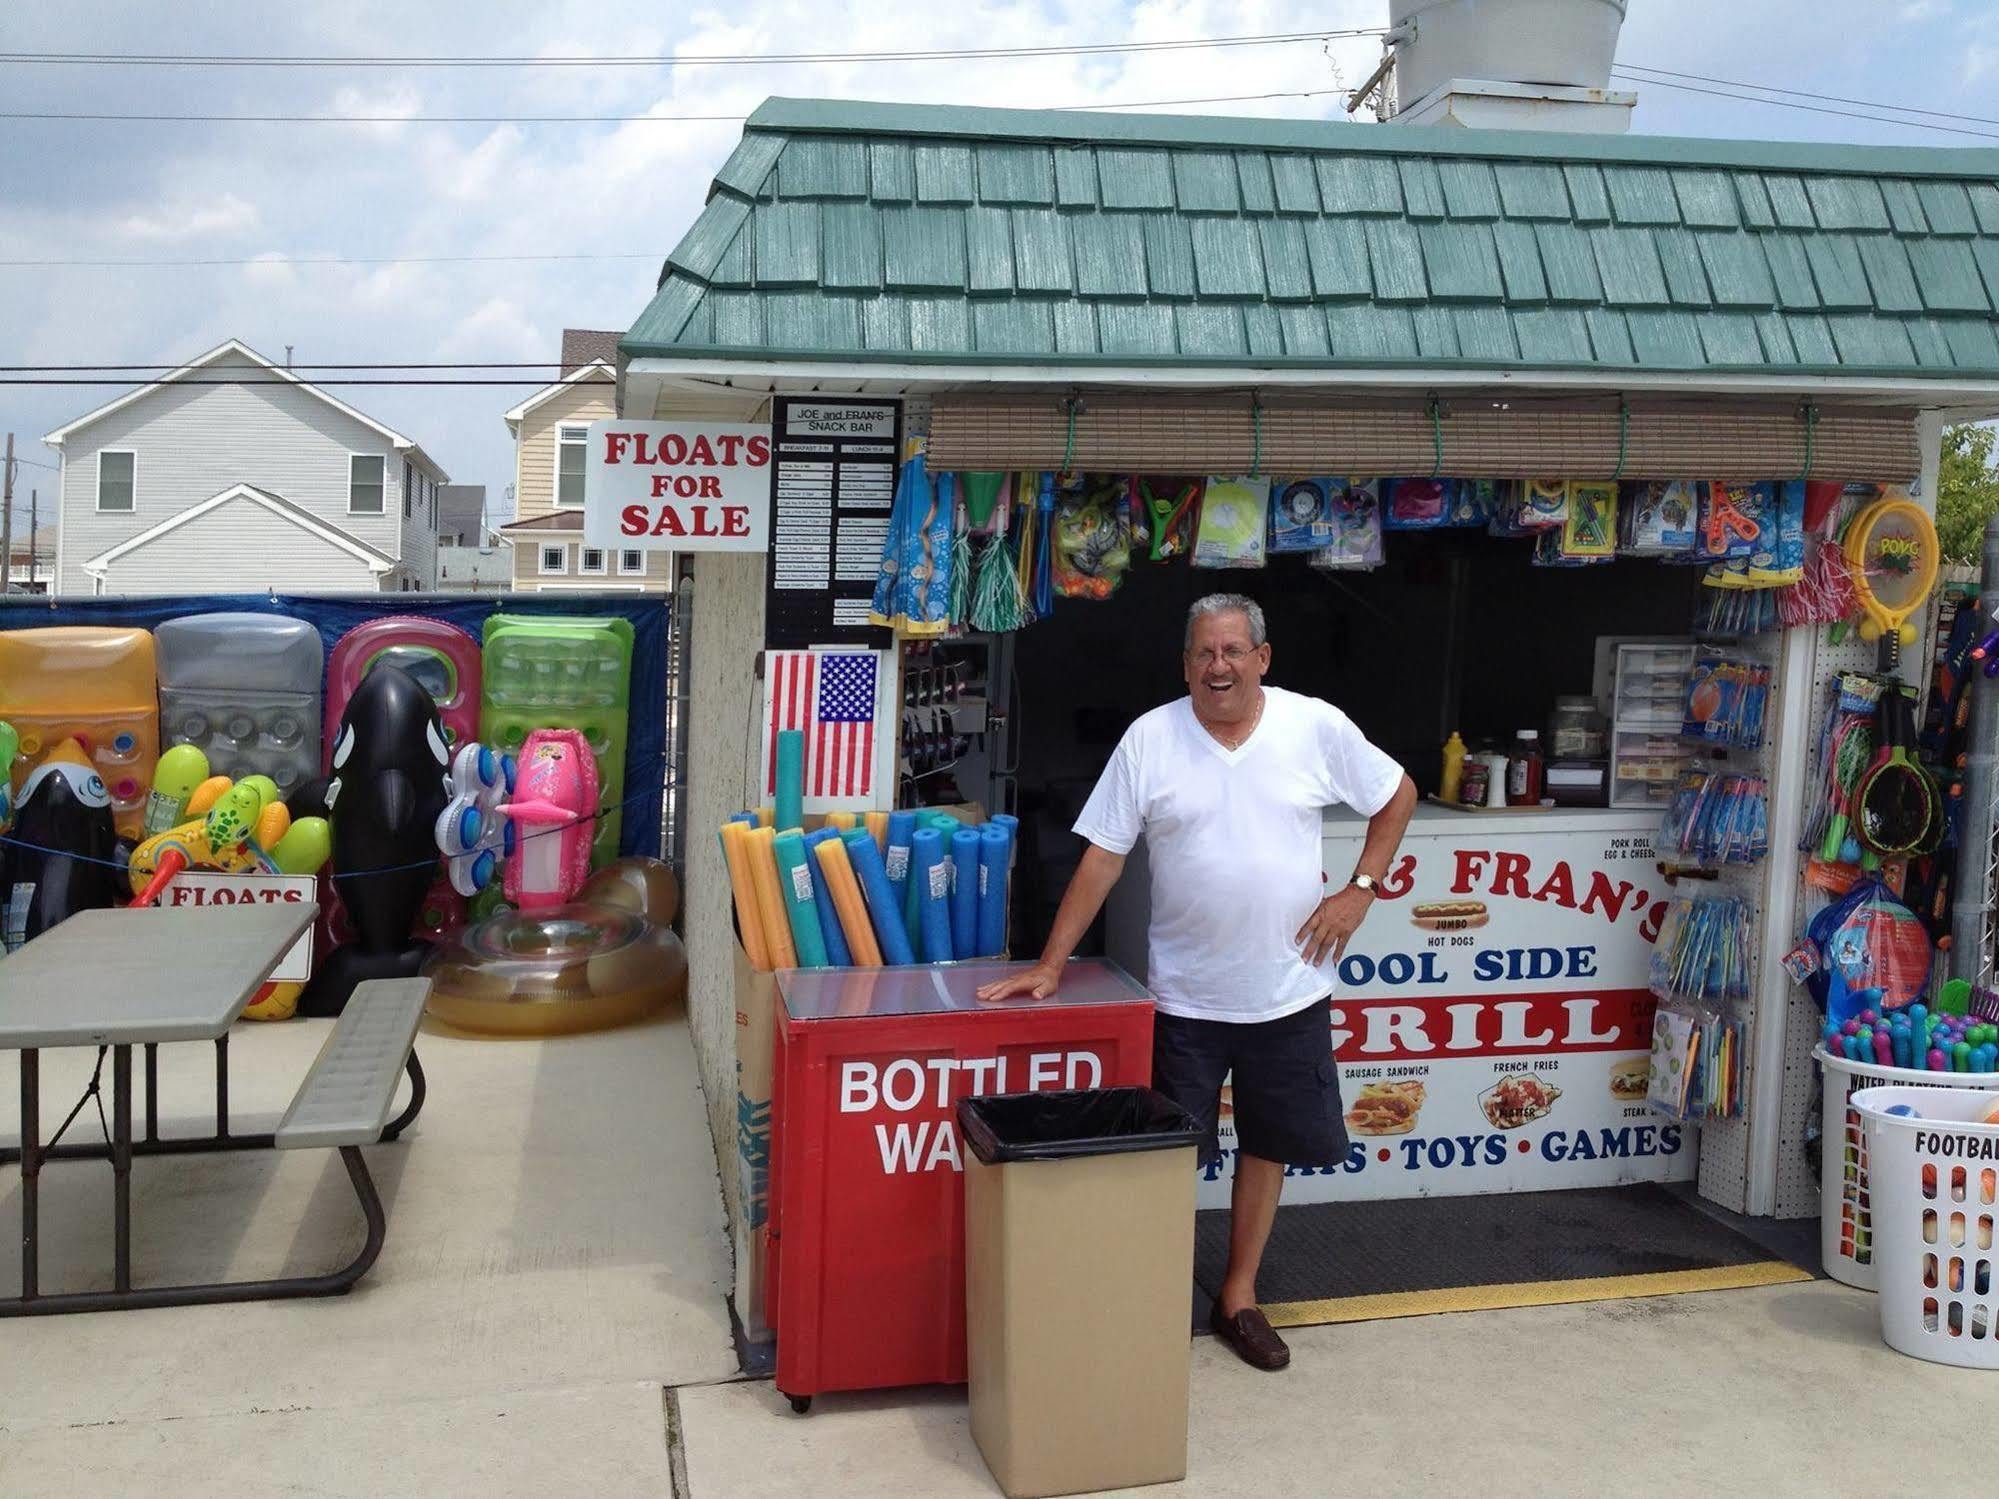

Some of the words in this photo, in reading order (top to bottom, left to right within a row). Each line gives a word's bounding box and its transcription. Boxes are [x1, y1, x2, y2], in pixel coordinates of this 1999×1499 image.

[797, 409, 820, 419] JOE
[823, 410, 843, 421] and
[808, 421, 847, 432] SNACK
[850, 422, 873, 433] BAR
[604, 433, 769, 467] FLOATS
[650, 475, 723, 498] FOR
[620, 504, 750, 537] SALE
[1610, 838, 1630, 848] PORK
[1633, 838, 1650, 848] ROLL
[1604, 850, 1618, 859] EGG
[1621, 850, 1627, 858] &
[170, 886, 303, 907] FLOATS
[1435, 919, 1468, 930] JUMBO
[1427, 937, 1446, 947] HOT
[1450, 936, 1474, 946] DOGS
[1338, 951, 1448, 986] OOL
[1473, 946, 1598, 981] SIDE
[1345, 1068, 1383, 1079] SAUSAGE
[1387, 1066, 1430, 1077] SANDWICH
[1493, 1061, 1528, 1073] FRENCH
[1534, 1060, 1559, 1071] FRIES
[1623, 1107, 1646, 1117] STEAK
[1400, 1134, 1507, 1170] TOYS
[1541, 1124, 1682, 1162] GAMES
